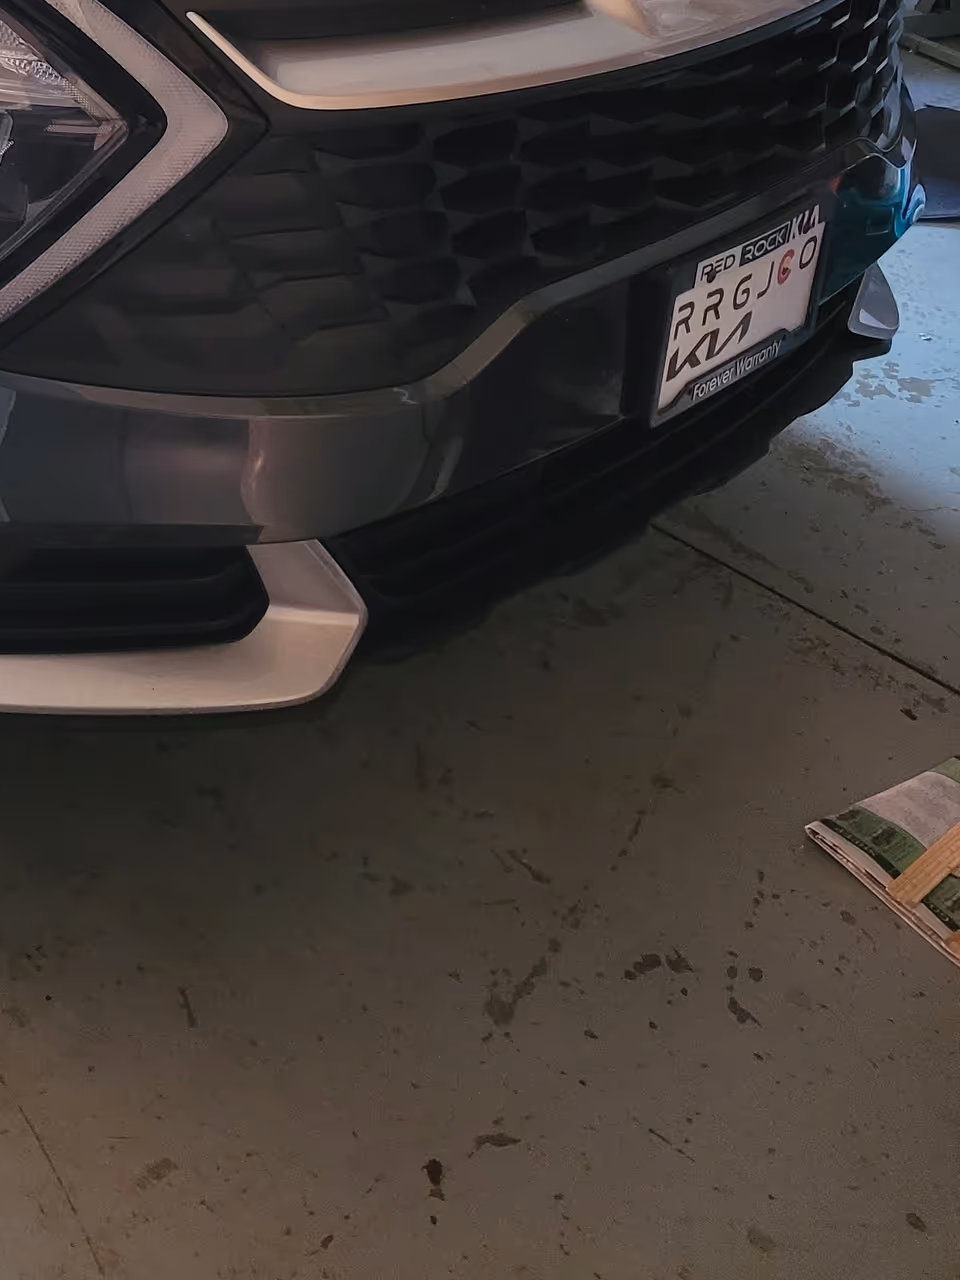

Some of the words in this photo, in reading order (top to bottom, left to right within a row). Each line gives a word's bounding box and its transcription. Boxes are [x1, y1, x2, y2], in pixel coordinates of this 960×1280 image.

[700, 253, 736, 282] RED
[744, 228, 786, 260] ROCK
[790, 204, 820, 240] KIA
[665, 310, 753, 382] KIA
[691, 368, 735, 401] Forever
[734, 339, 782, 376] Warranty
